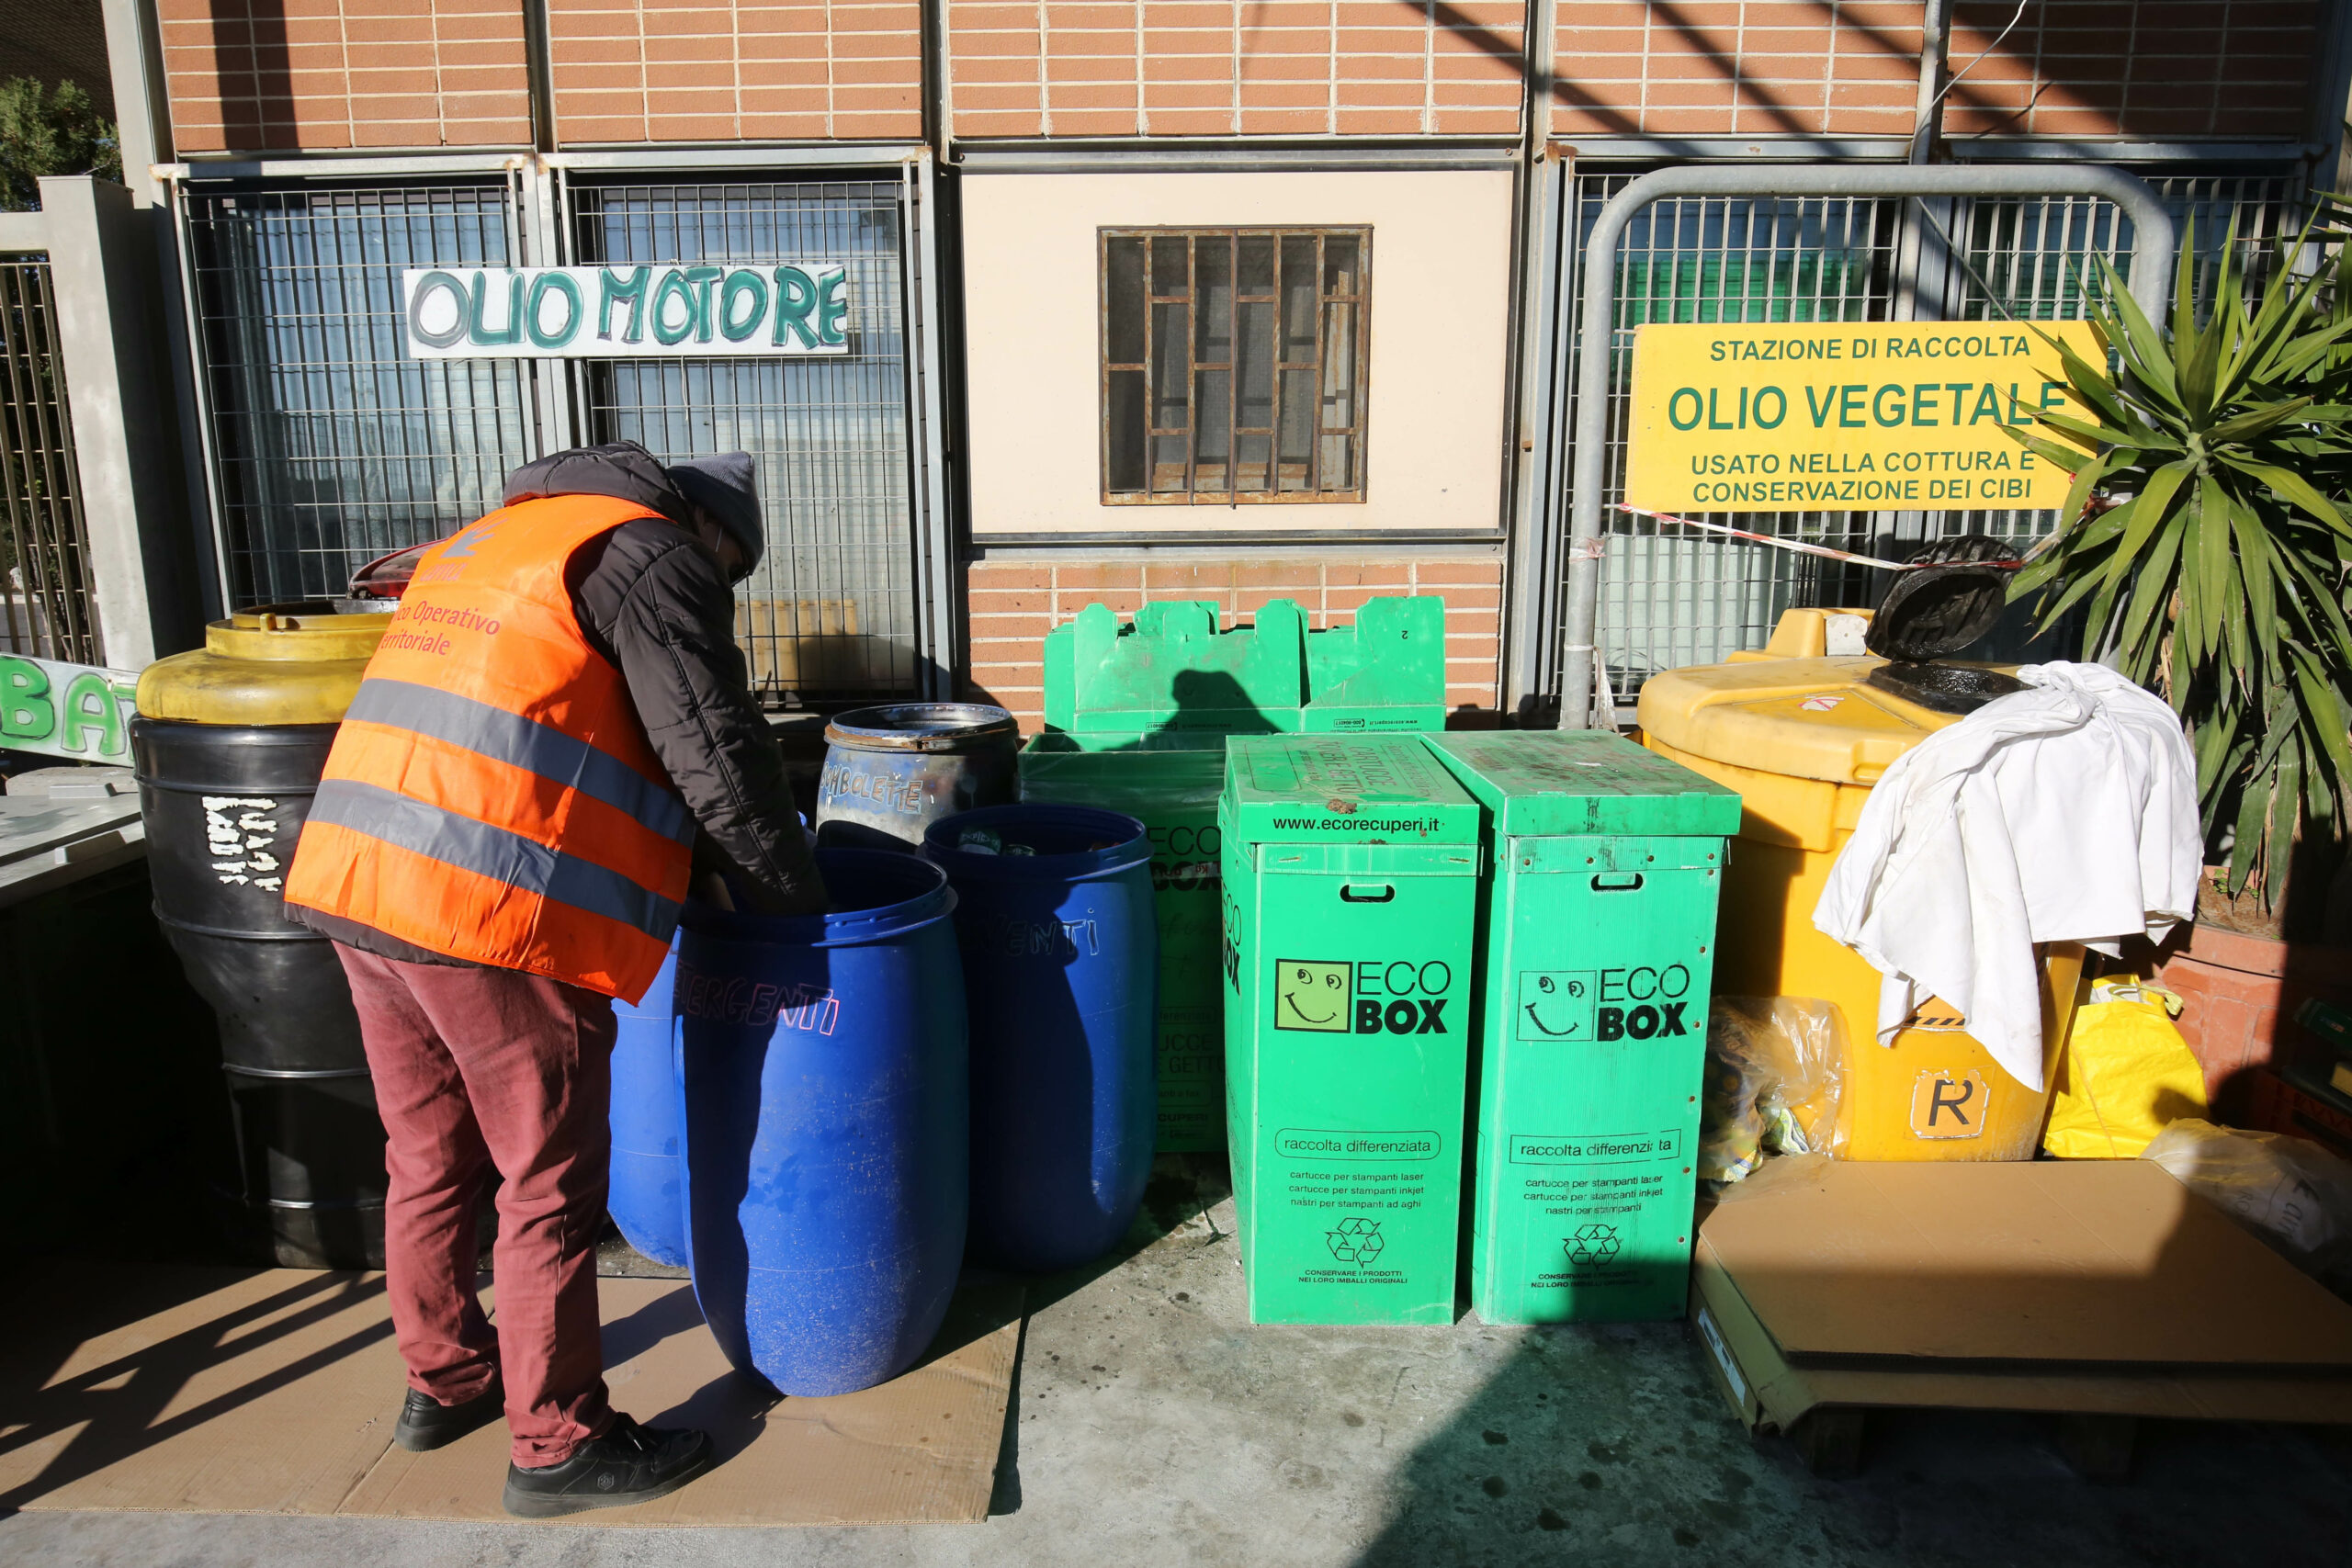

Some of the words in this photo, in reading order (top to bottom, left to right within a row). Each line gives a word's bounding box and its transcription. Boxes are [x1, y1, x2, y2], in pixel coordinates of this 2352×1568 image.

[410, 267, 583, 349] OLIO
[596, 265, 847, 350] MOTORE
[1710, 338, 1842, 362] STAZIONE
[1851, 338, 1877, 360] DI
[1885, 336, 2031, 359] RACCOLTA
[1668, 385, 1788, 432] OLIO
[1804, 381, 2068, 430] VEGETALE
[1690, 454, 1781, 476] USATO
[1790, 452, 1875, 474] NELLA
[1883, 450, 2011, 473] COTTURA
[2019, 450, 2036, 471] E
[1692, 479, 1920, 503] CONSERVAZIONE
[1929, 479, 1971, 500] DEI
[1979, 478, 2032, 499] CIBI
[413, 599, 501, 636] Operativo
[1272, 816, 1441, 835] www.ecorecuperi.it
[1356, 960, 1452, 996] ECO
[1600, 964, 1690, 1002] ECO
[1355, 998, 1449, 1035] BOX
[1597, 1001, 1688, 1042] BOX
[1928, 1078, 1973, 1126] R
[1284, 1138, 1342, 1153] raccolta
[1346, 1140, 1430, 1153] differenziata
[1521, 1144, 1581, 1156] raccolta
[1290, 1171, 1330, 1180] cartucce
[1333, 1173, 1349, 1182] per
[1351, 1173, 1398, 1182] stampanti
[1400, 1173, 1424, 1181] laser
[1525, 1179, 1569, 1188] cartucce
[1572, 1179, 1589, 1189] per
[1591, 1176, 1638, 1188] stampanti
[1288, 1185, 1329, 1194] cartucce
[1332, 1186, 1348, 1195] per
[1351, 1187, 1396, 1196] stampanti
[1399, 1186, 1424, 1196] inkjet
[1523, 1191, 1567, 1201] cartucce
[1570, 1193, 1587, 1203] per
[1589, 1190, 1636, 1201] stampanti
[1291, 1198, 1317, 1207] nastri
[1319, 1200, 1335, 1209] per
[1338, 1200, 1384, 1209] stampanti
[1401, 1200, 1421, 1210] aghi
[1545, 1206, 1573, 1215] nastri
[1575, 1207, 1593, 1216] per
